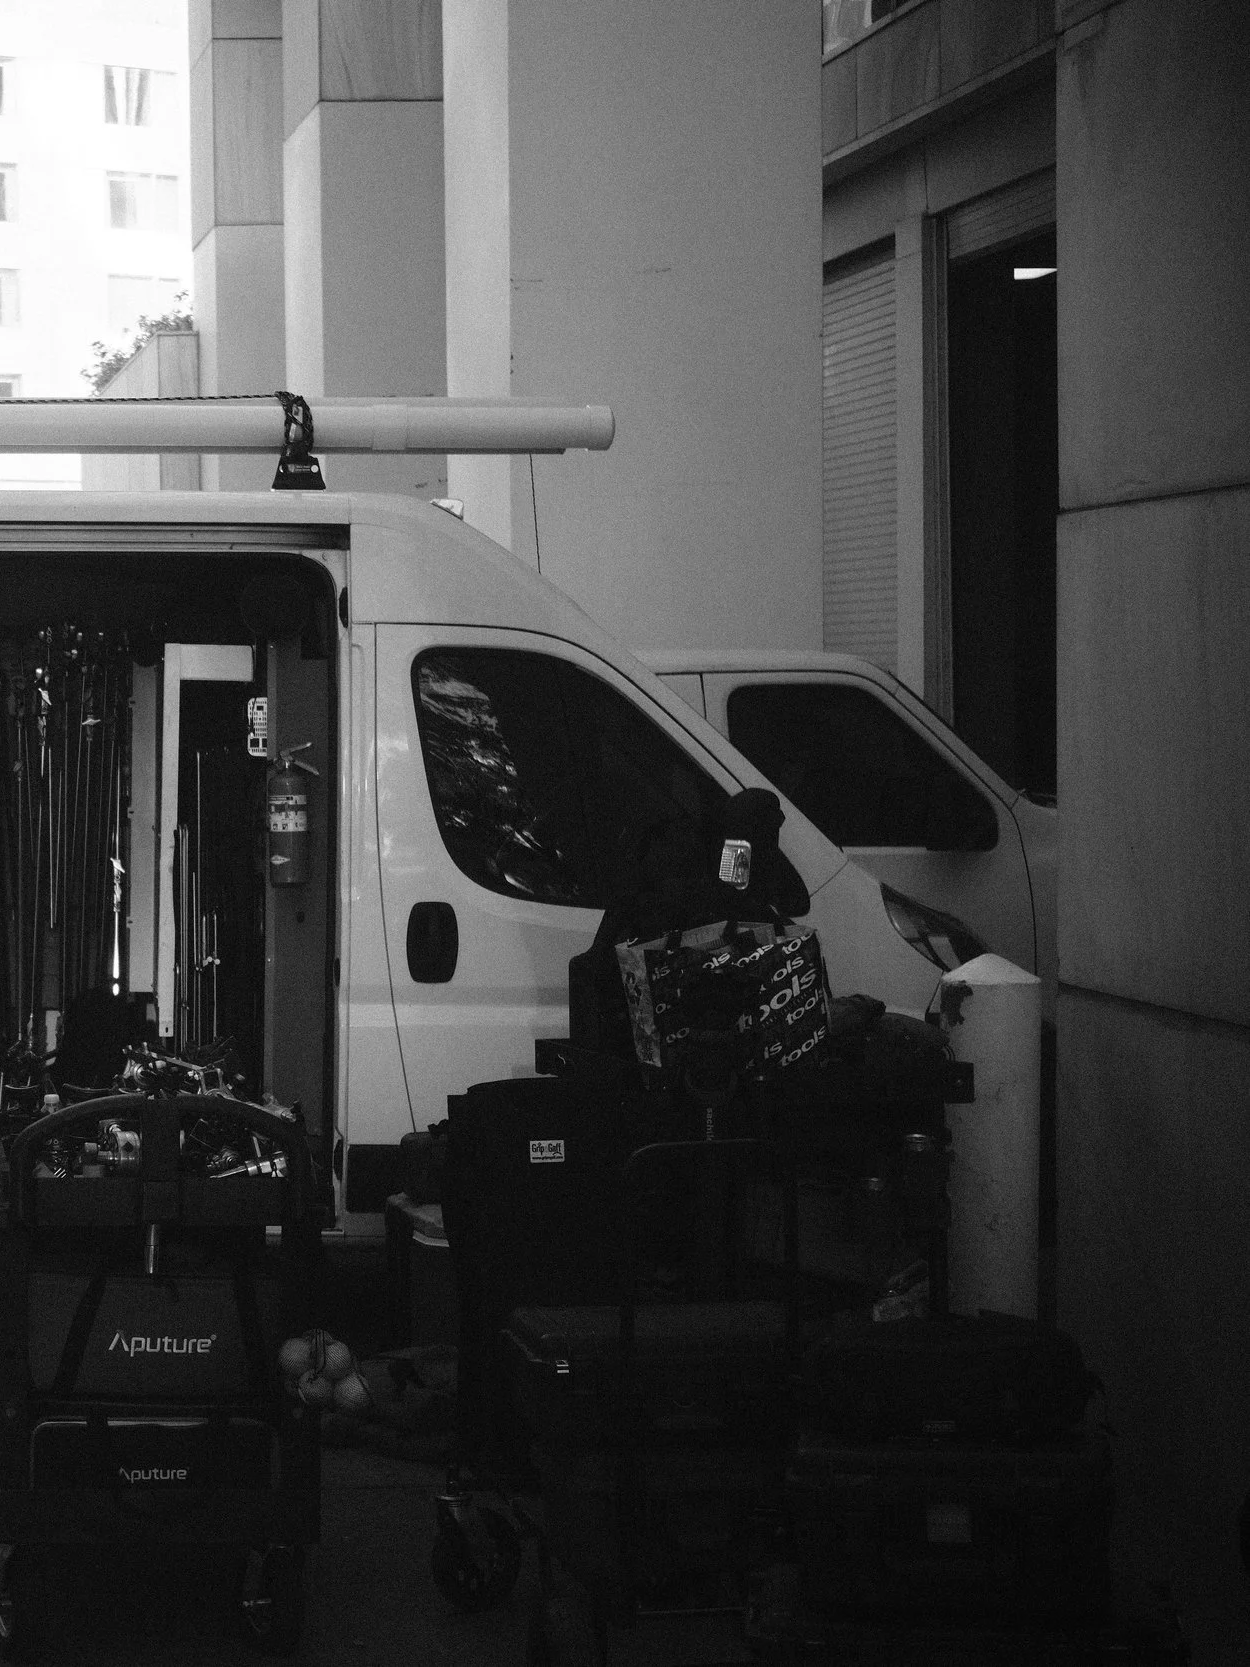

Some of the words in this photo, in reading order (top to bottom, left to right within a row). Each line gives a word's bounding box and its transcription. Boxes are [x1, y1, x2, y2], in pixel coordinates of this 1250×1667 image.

[780, 1025, 826, 1067] tools
[108, 1329, 215, 1357] Aputure
[119, 1465, 188, 1484] Aputure
